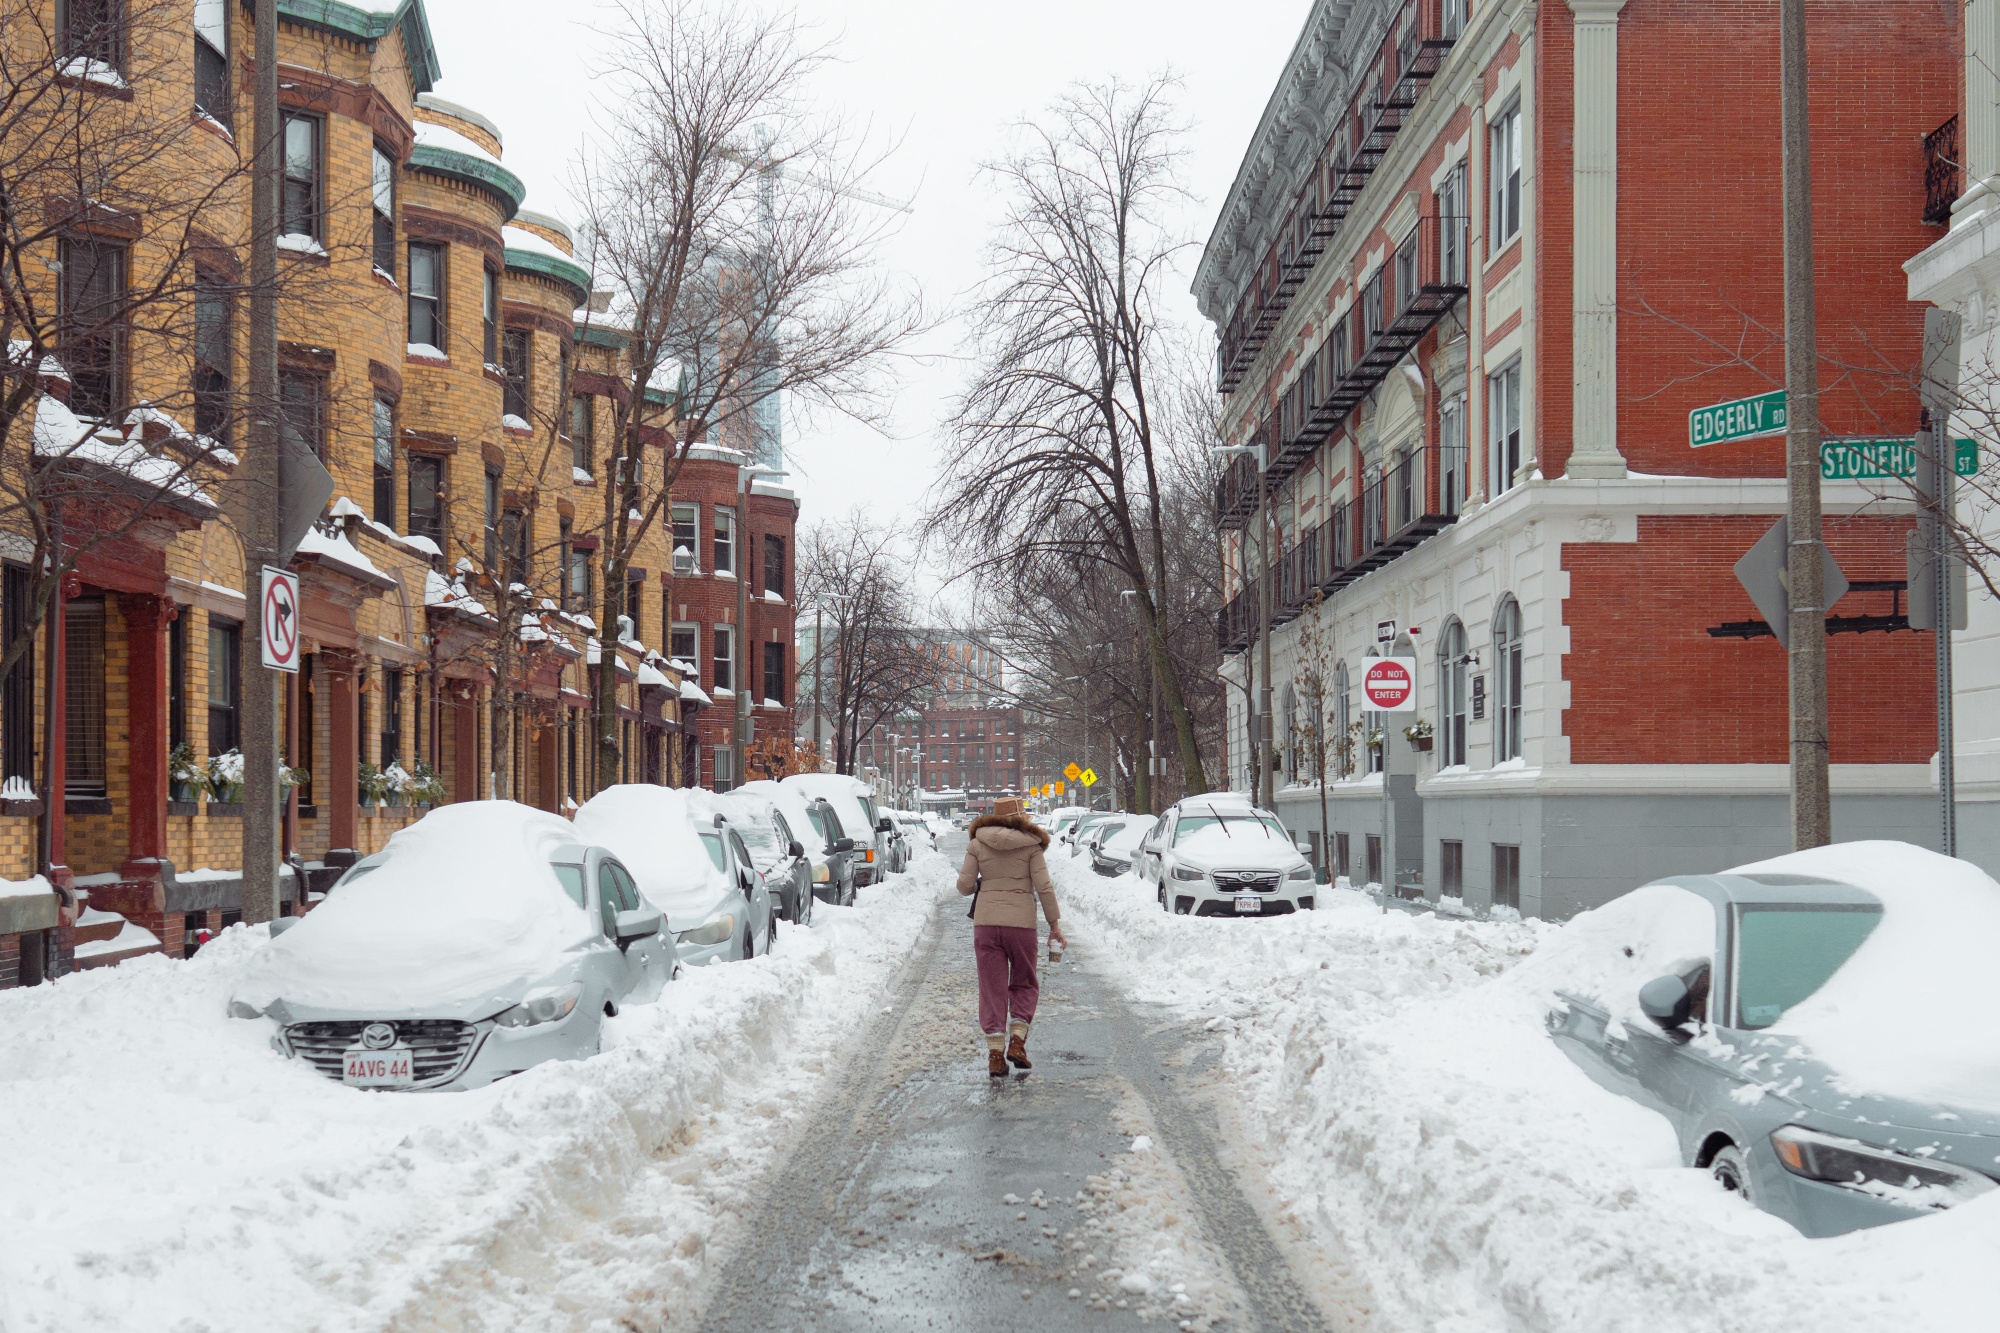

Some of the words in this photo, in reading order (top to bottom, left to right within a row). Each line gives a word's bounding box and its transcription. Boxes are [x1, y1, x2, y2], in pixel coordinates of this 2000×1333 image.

[1693, 400, 1764, 441] EDGERLY
[1773, 408, 1785, 425] RD
[1824, 445, 1916, 477] STONEHO
[1958, 456, 1971, 472] ST
[1371, 670, 1382, 678] DO
[1388, 670, 1404, 678] NOT
[1374, 690, 1401, 699] ENTER
[1236, 901, 1251, 909] 7KPH
[1252, 901, 1260, 909] 40
[347, 1060, 386, 1077] 4AVG
[390, 1060, 408, 1077] 44
